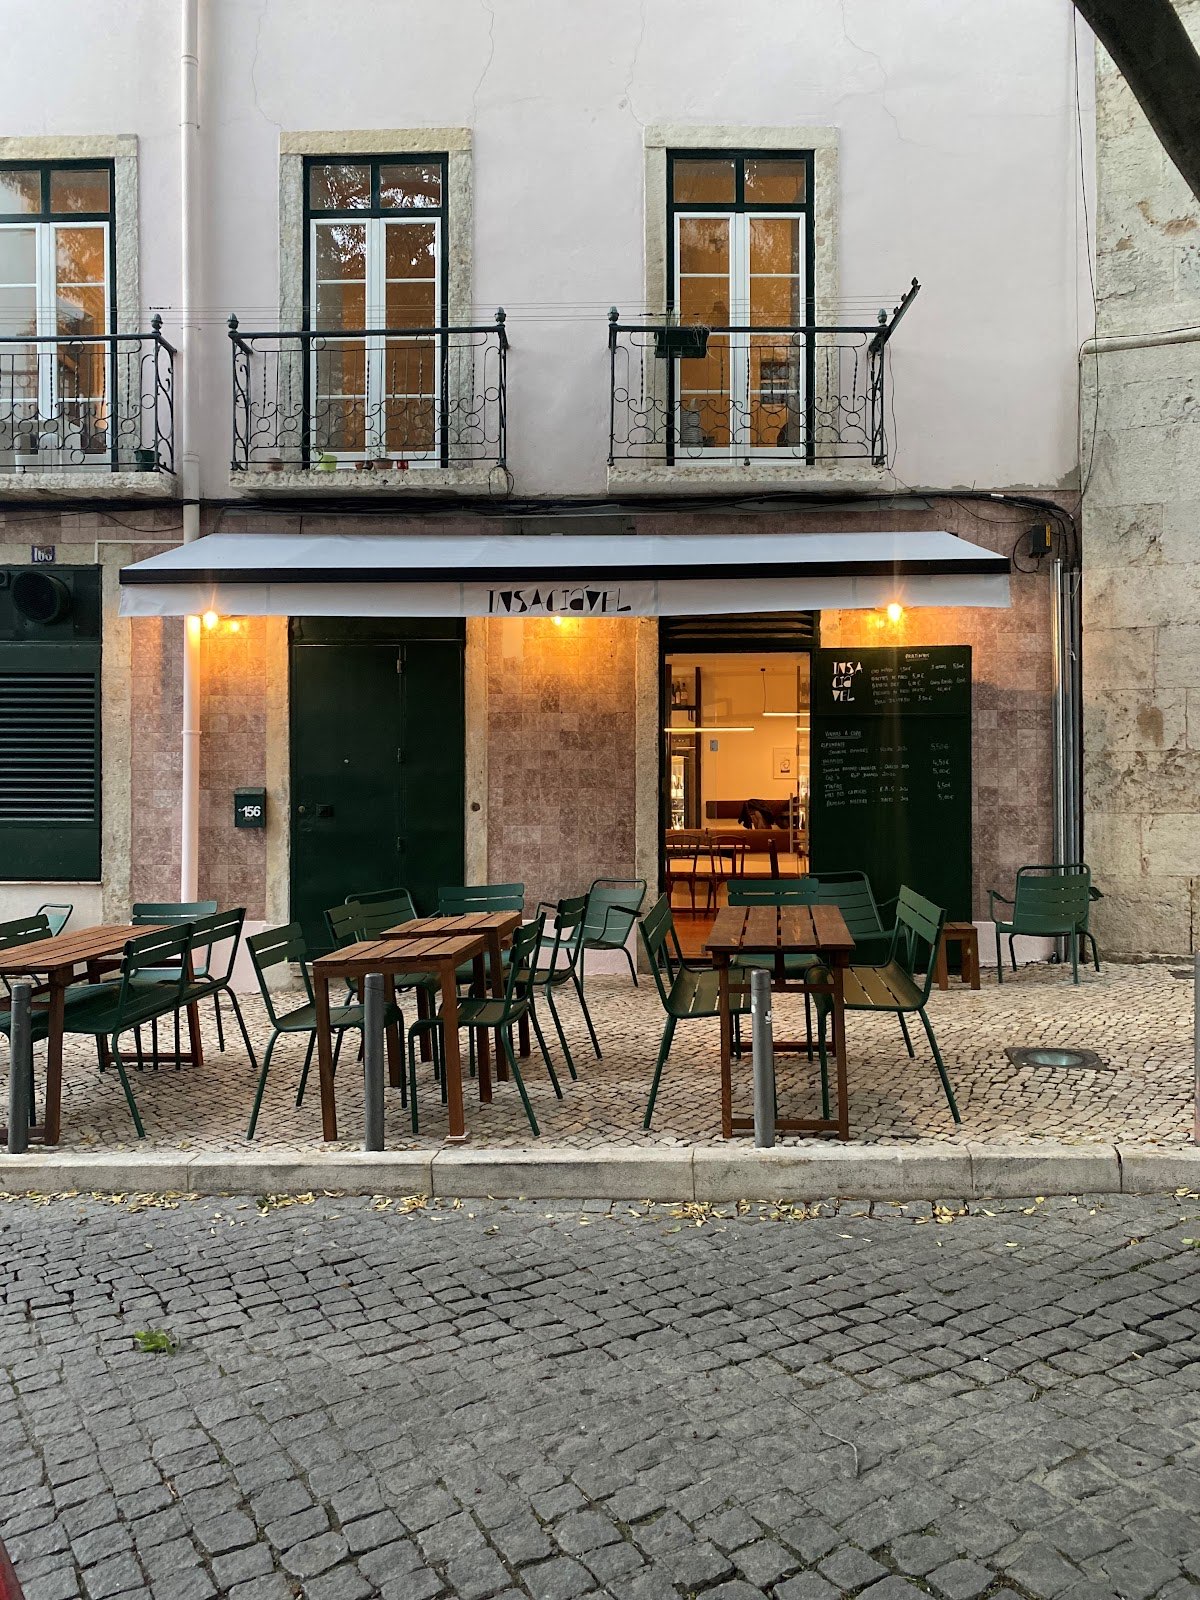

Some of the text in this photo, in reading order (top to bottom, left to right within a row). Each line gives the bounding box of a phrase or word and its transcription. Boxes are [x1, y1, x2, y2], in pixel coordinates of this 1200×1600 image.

[832, 661, 863, 675] INSA
[832, 689, 855, 702] VEL
[241, 805, 261, 817] 156
